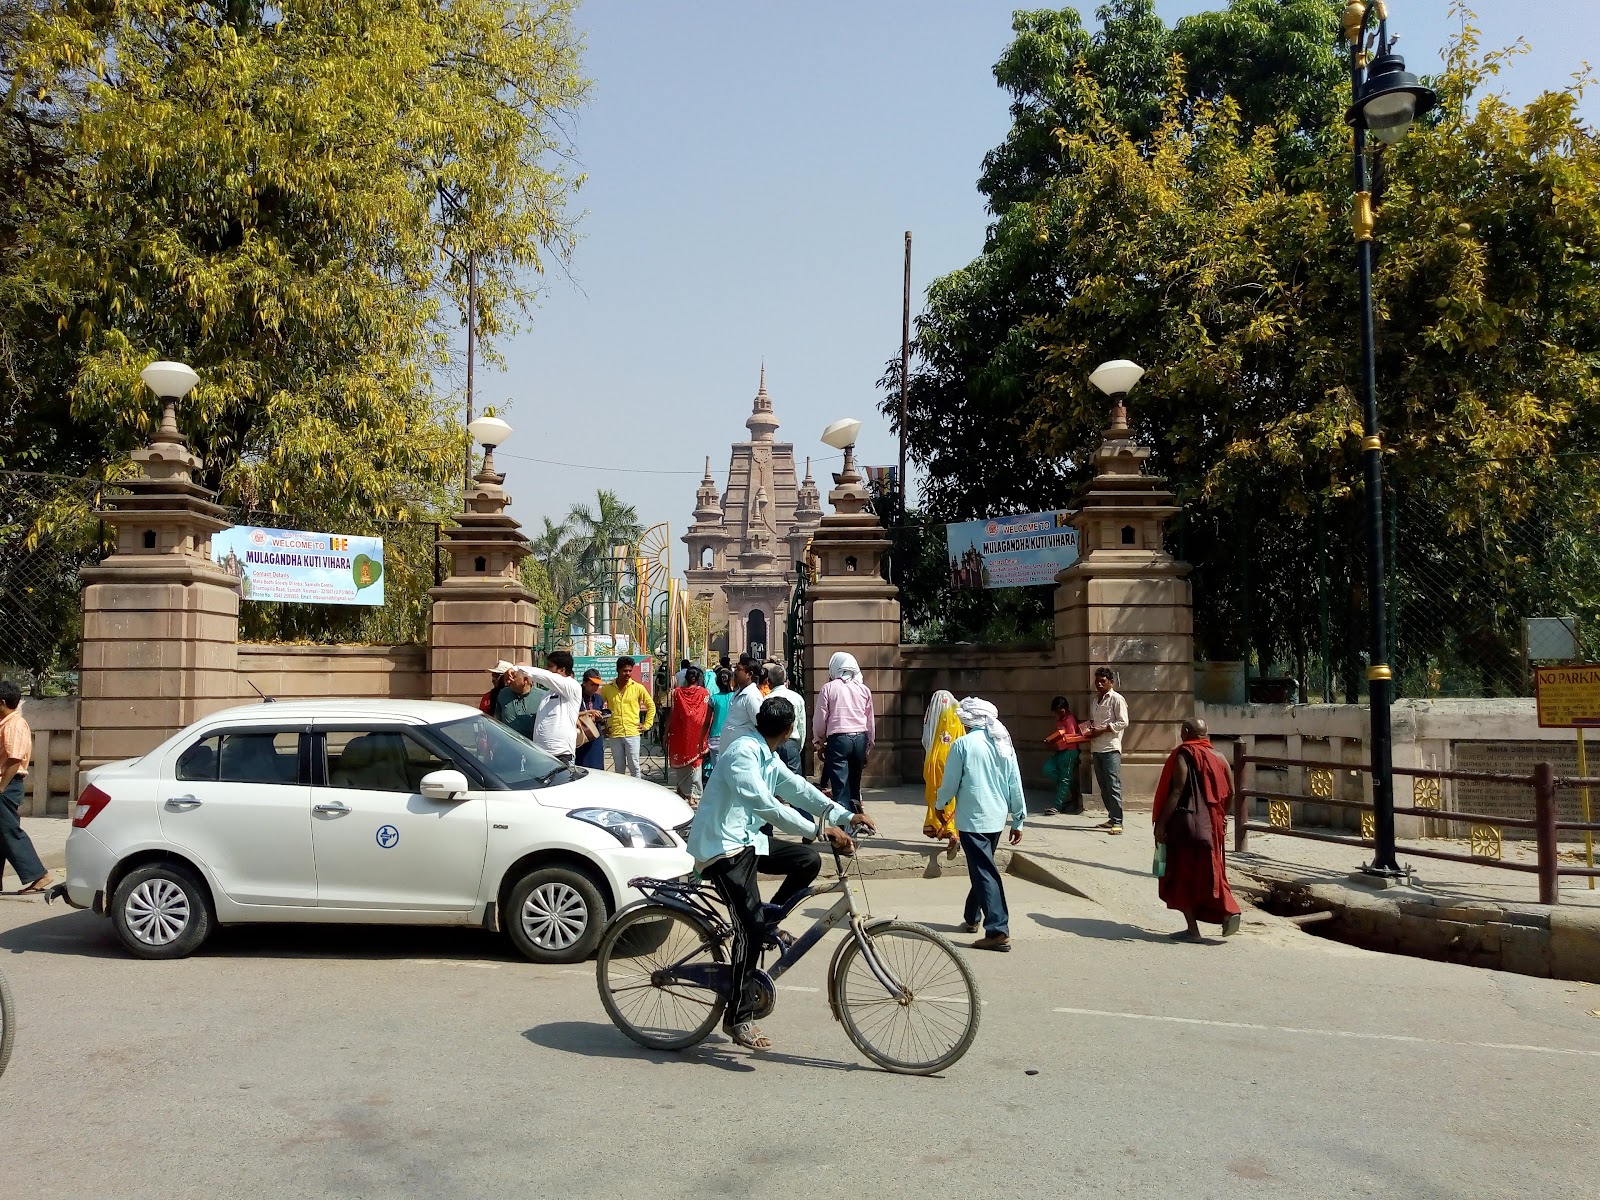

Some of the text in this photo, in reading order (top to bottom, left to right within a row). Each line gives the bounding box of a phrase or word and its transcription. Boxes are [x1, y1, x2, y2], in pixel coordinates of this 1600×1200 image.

[1003, 522, 1050, 534] WELCOME TO
[272, 539, 325, 550] WELCOME TO
[983, 532, 1076, 555] MULAGANDHA KUTI VIHARA
[246, 550, 351, 569] MULAGANDHA KUTI VIHARA
[1540, 673, 1556, 684] NO
[1535, 746, 1567, 754] SOCIETY
